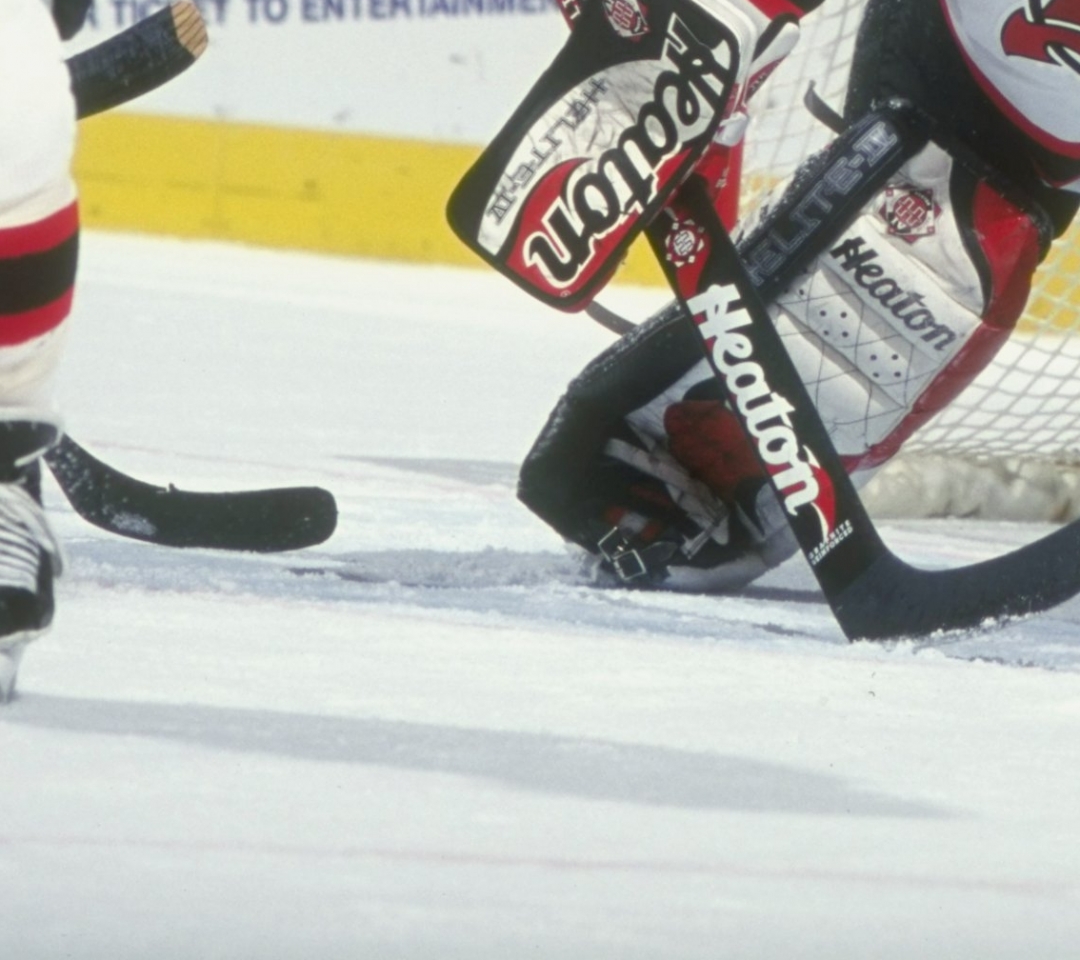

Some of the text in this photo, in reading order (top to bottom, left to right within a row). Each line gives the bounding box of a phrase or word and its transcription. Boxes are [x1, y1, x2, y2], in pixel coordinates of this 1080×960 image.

[523, 11, 732, 289] Heaton
[686, 283, 820, 517] Heaton
[831, 236, 957, 352] Heaton
